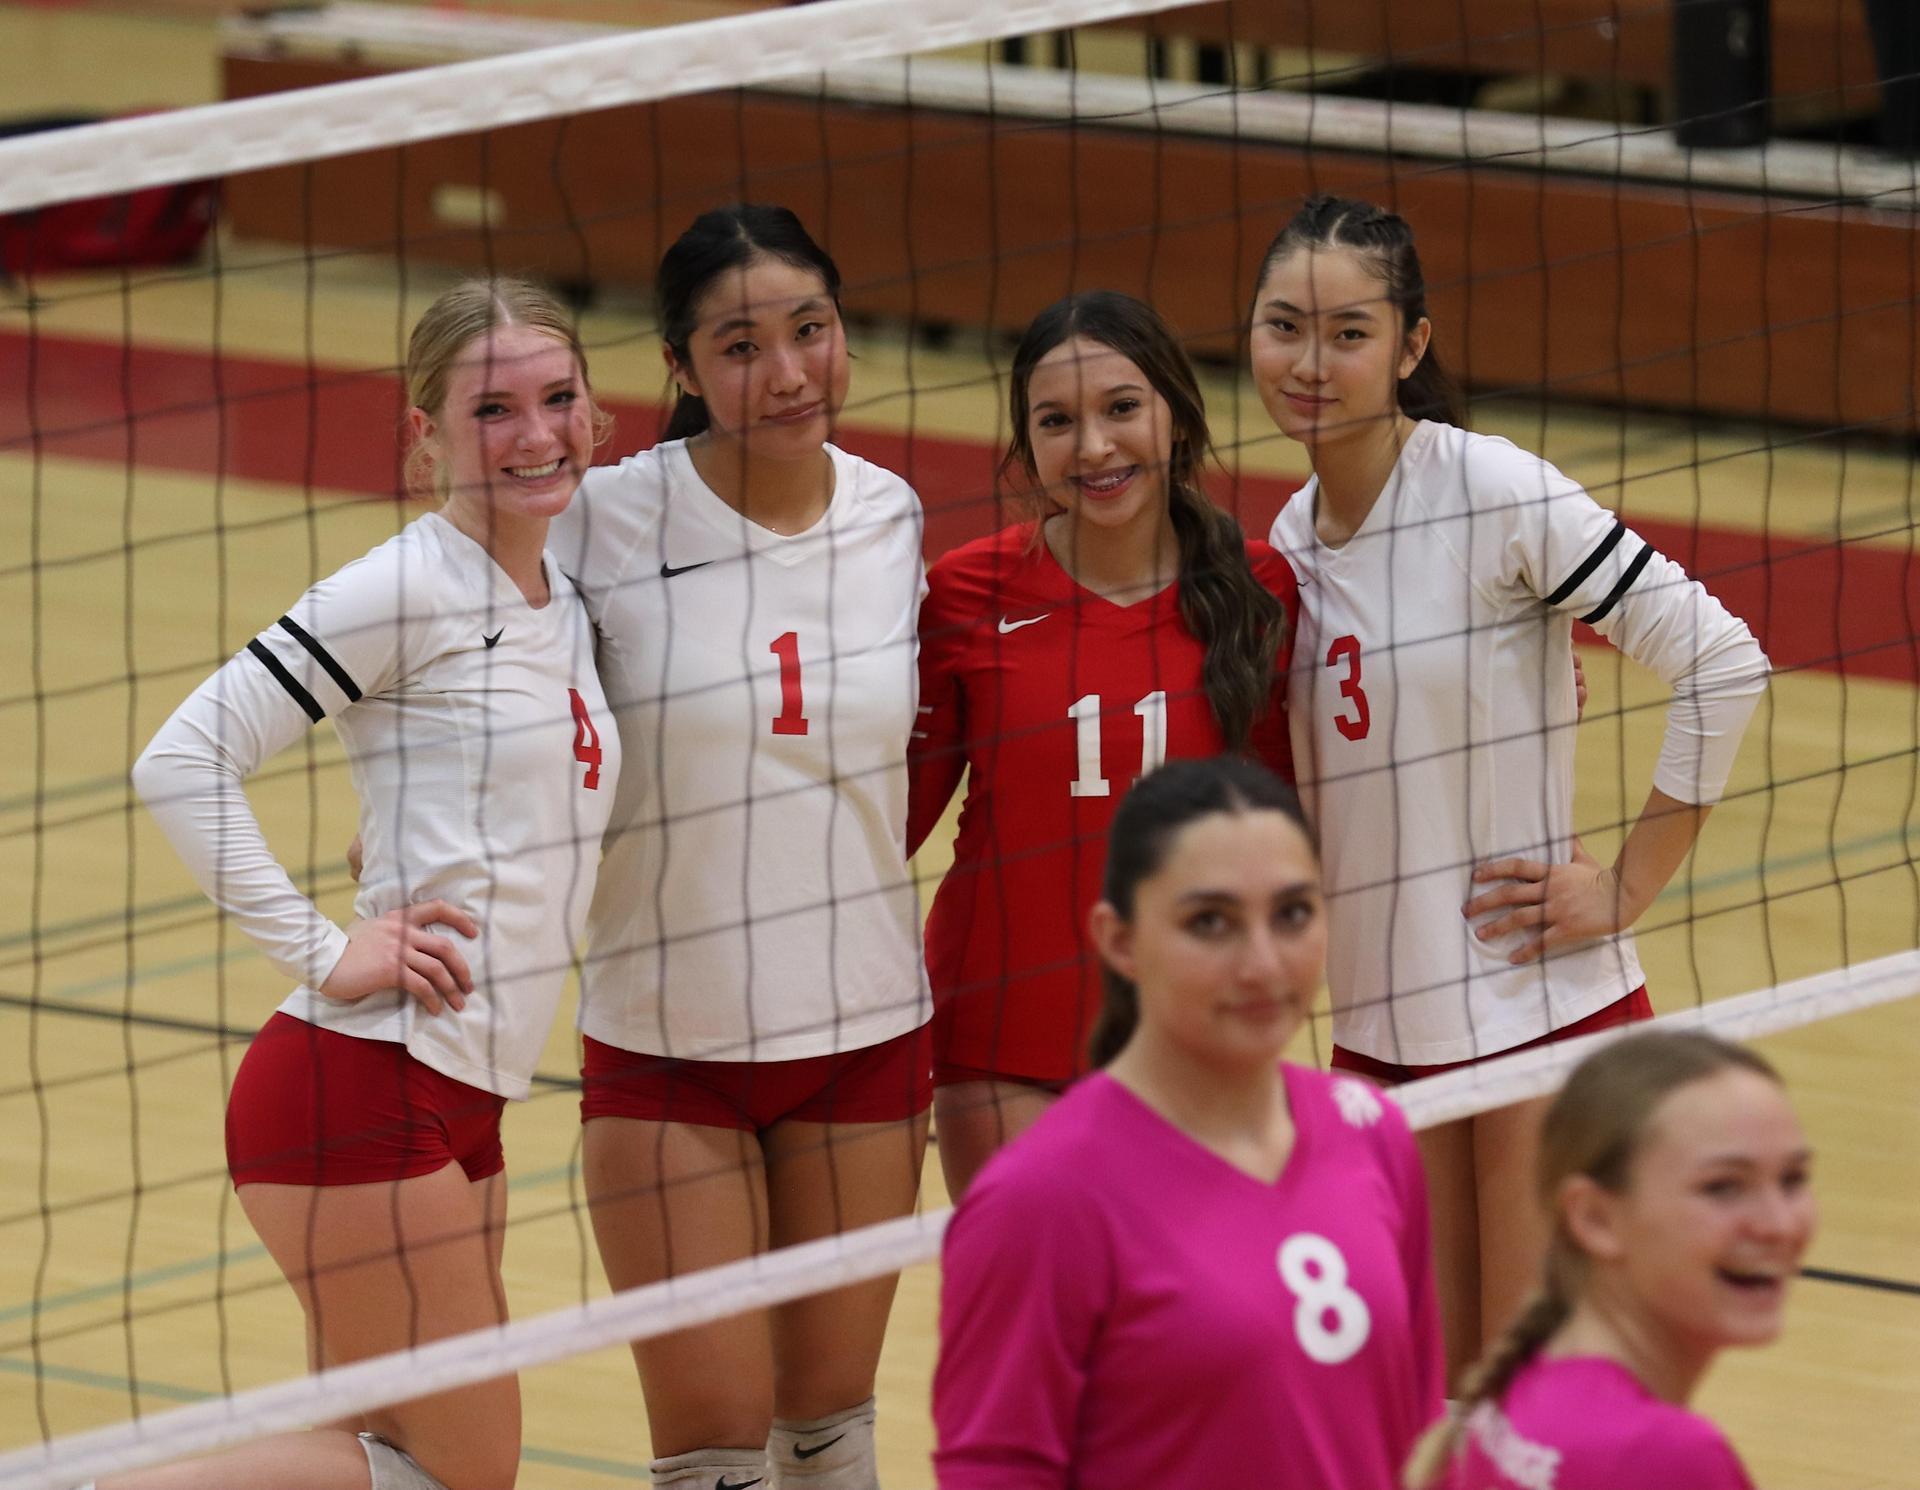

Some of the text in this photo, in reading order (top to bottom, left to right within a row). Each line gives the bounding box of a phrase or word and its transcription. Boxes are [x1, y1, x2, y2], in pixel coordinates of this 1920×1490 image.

[770, 632, 808, 735] 1
[1326, 635, 1370, 741] 3
[568, 688, 602, 790] 4
[1068, 690, 1167, 797] 11
[1277, 1232, 1371, 1365] 8
